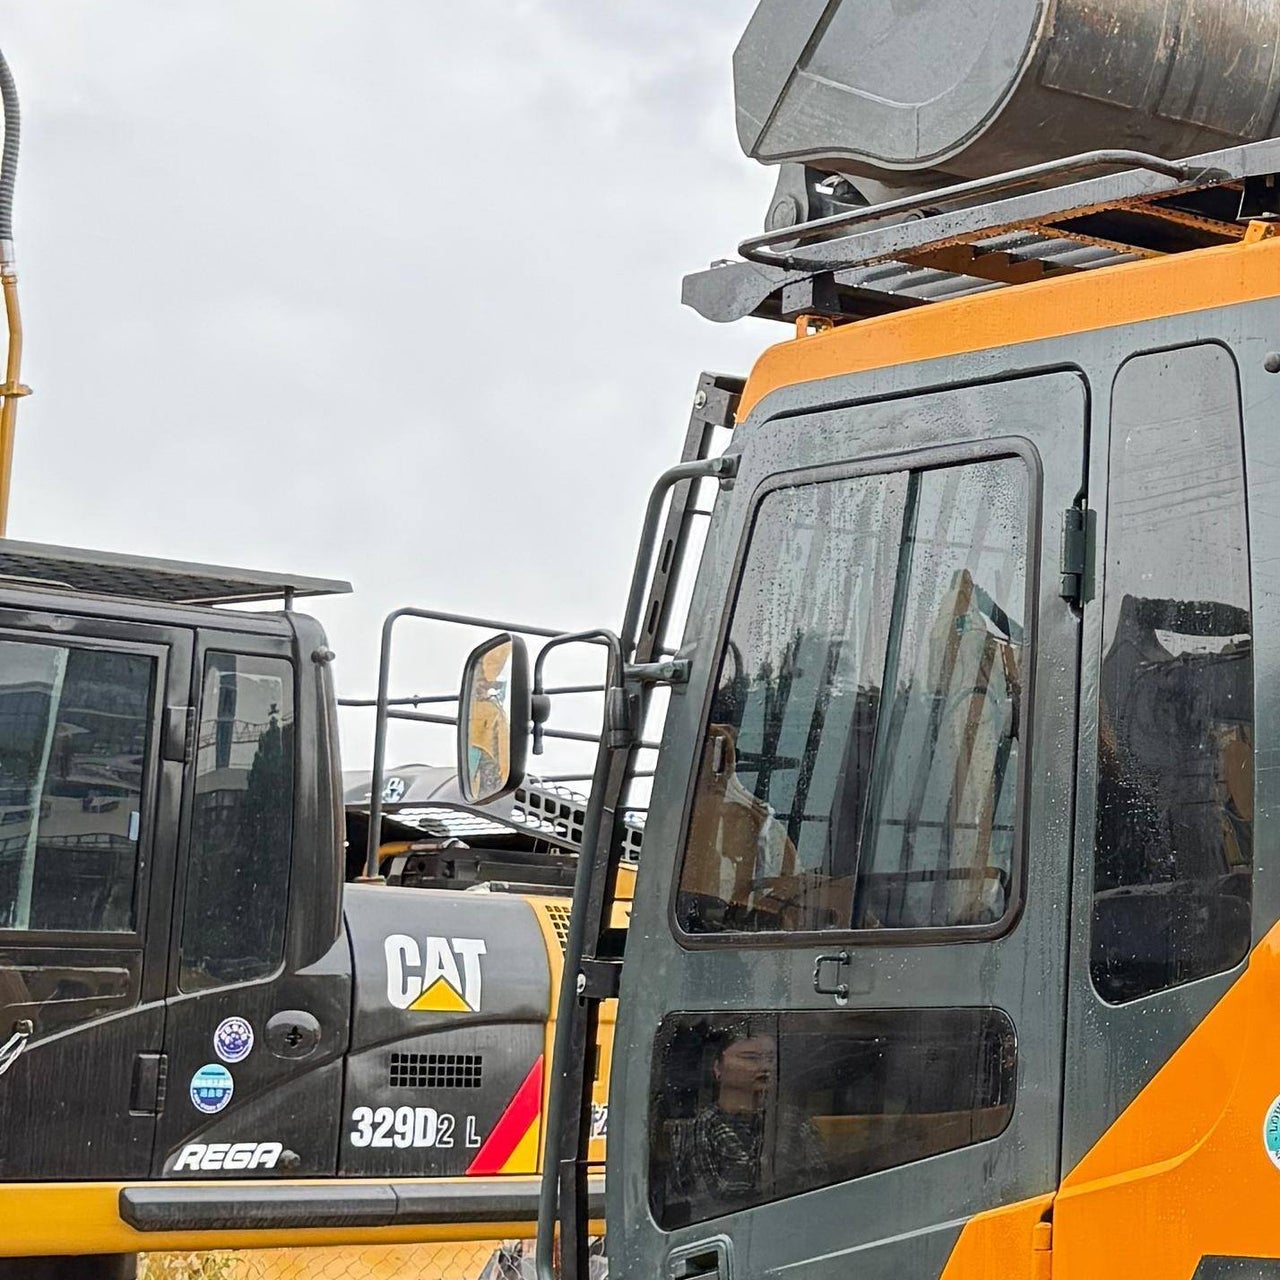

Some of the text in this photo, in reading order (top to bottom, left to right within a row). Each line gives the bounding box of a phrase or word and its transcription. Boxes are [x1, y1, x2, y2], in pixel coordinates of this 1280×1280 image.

[384, 934, 487, 1012] CAT
[465, 1115, 482, 1148] L
[173, 1142, 283, 1171] REGA
